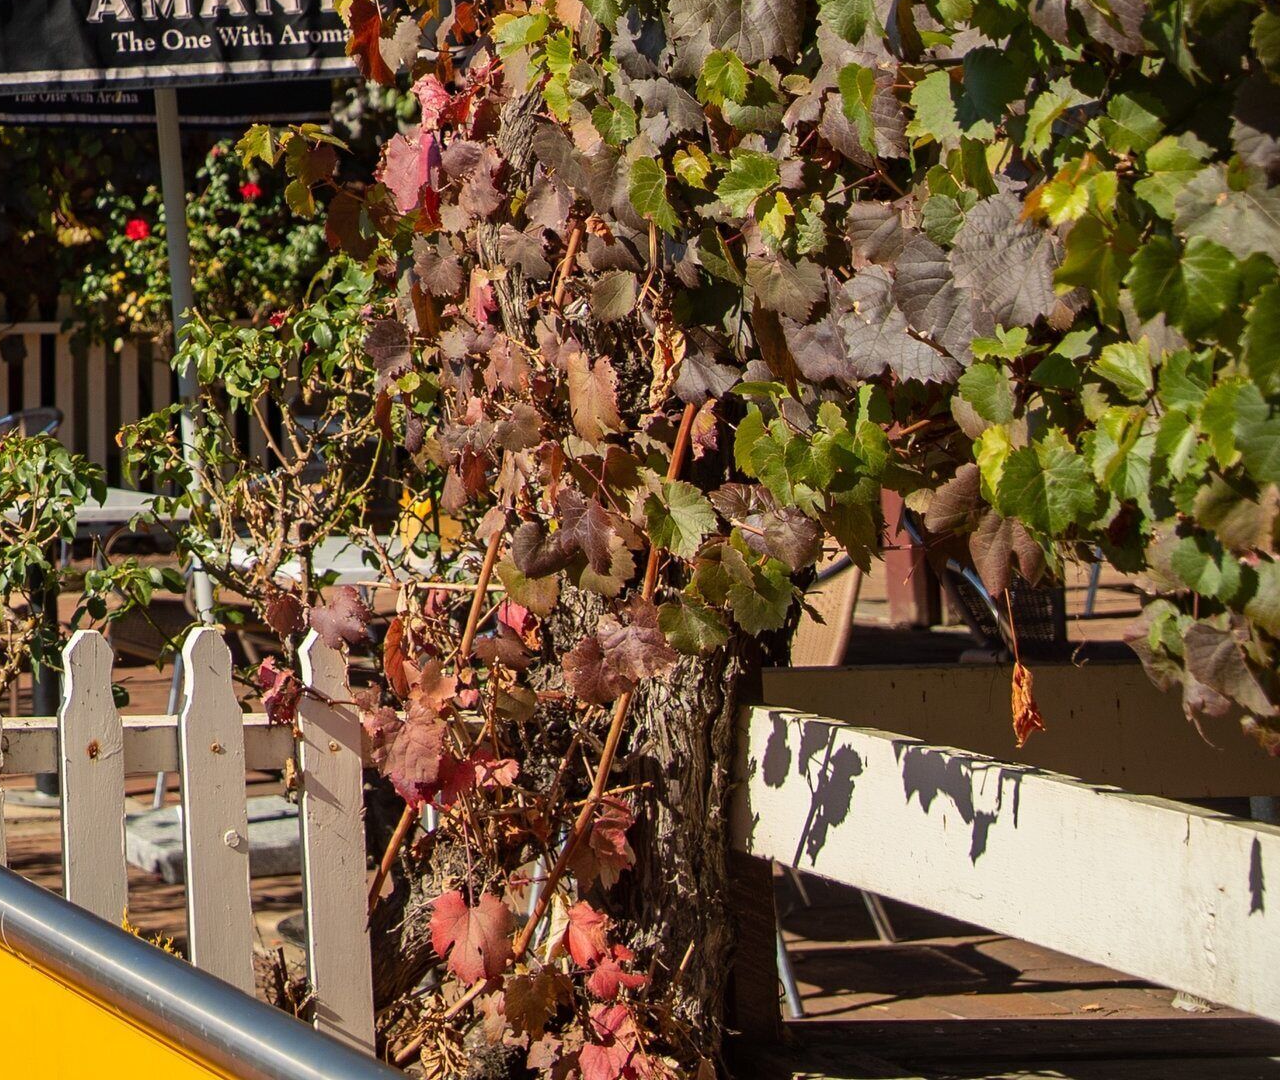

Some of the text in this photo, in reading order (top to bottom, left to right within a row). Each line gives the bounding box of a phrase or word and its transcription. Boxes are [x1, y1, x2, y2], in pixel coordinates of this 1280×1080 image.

[110, 30, 156, 53] The
[162, 28, 212, 51] One
[216, 24, 274, 48] With
